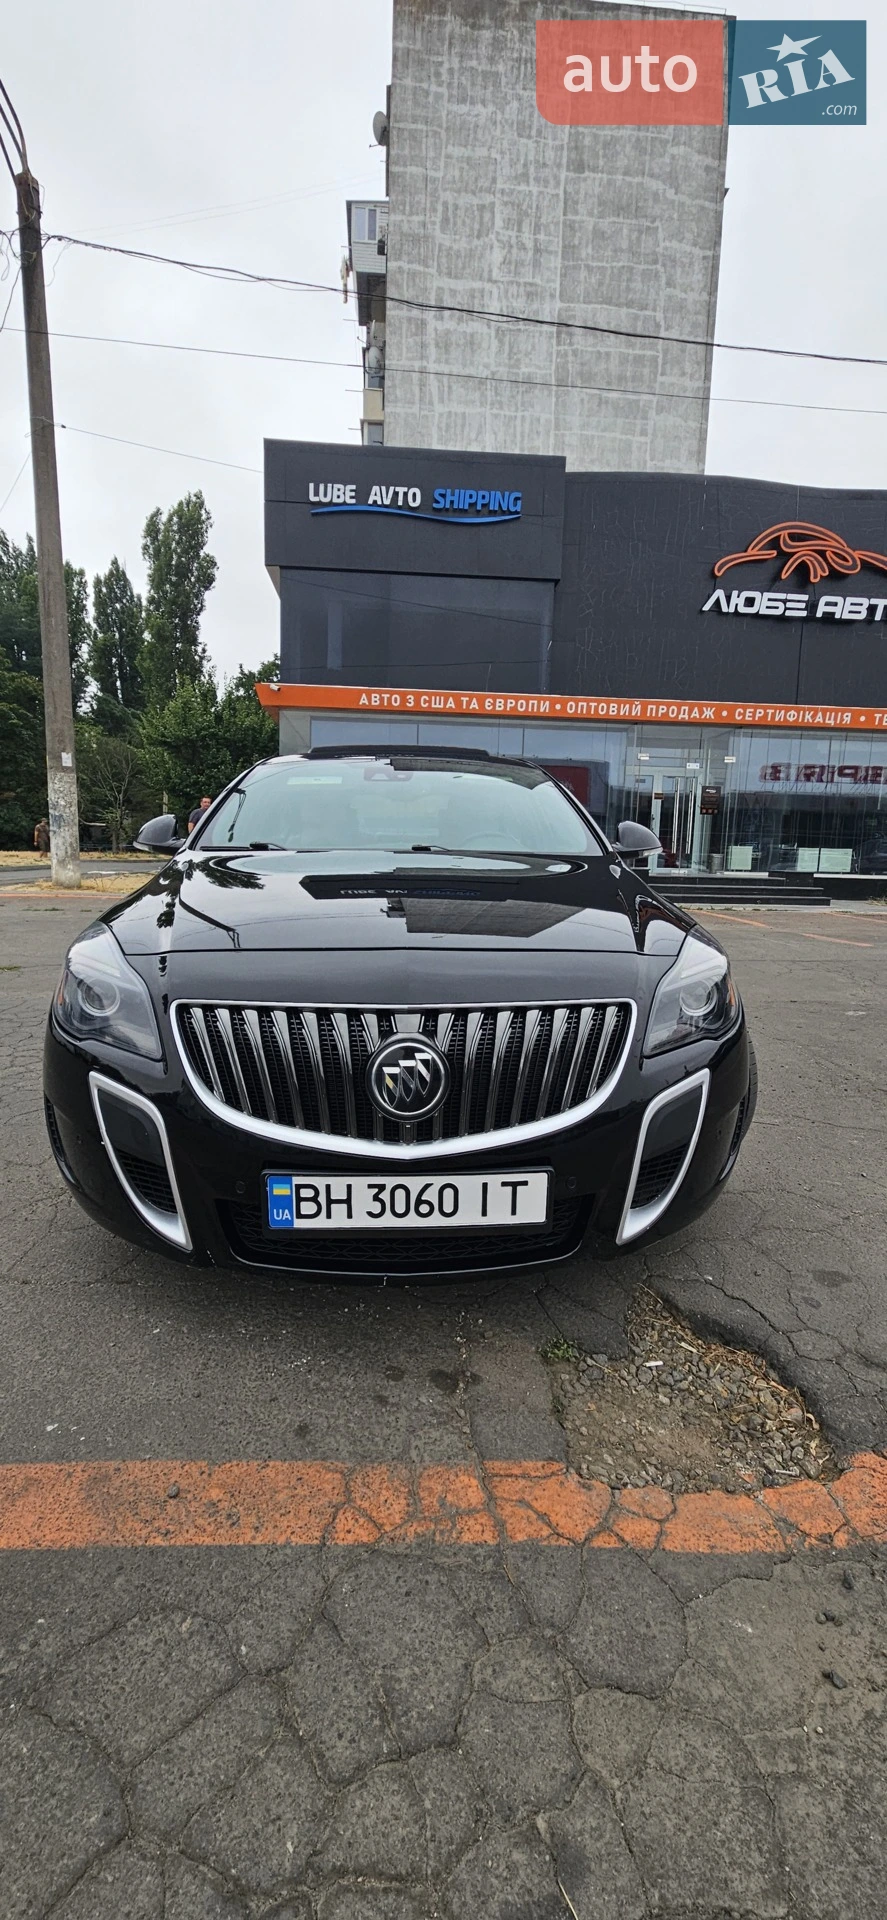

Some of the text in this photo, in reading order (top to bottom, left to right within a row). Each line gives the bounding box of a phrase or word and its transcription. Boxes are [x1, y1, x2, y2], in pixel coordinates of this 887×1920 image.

[308, 482, 522, 512] LUBE AVTO SHIPPING
[702, 589, 809, 617] ЛЮБЕ
[359, 693, 401, 707] АВТО
[420, 695, 456, 709] США
[460, 697, 479, 710] ТА
[484, 698, 550, 713] ЄВРОПИ
[566, 701, 642, 717] ОПТОВИЙ
[646, 704, 716, 720] ПРОДАЖ
[735, 708, 852, 726] СЕРТИФІКАЦІЯ
[273, 1208, 292, 1220] UA
[294, 1183, 353, 1219] BH
[366, 1182, 460, 1219] 3060
